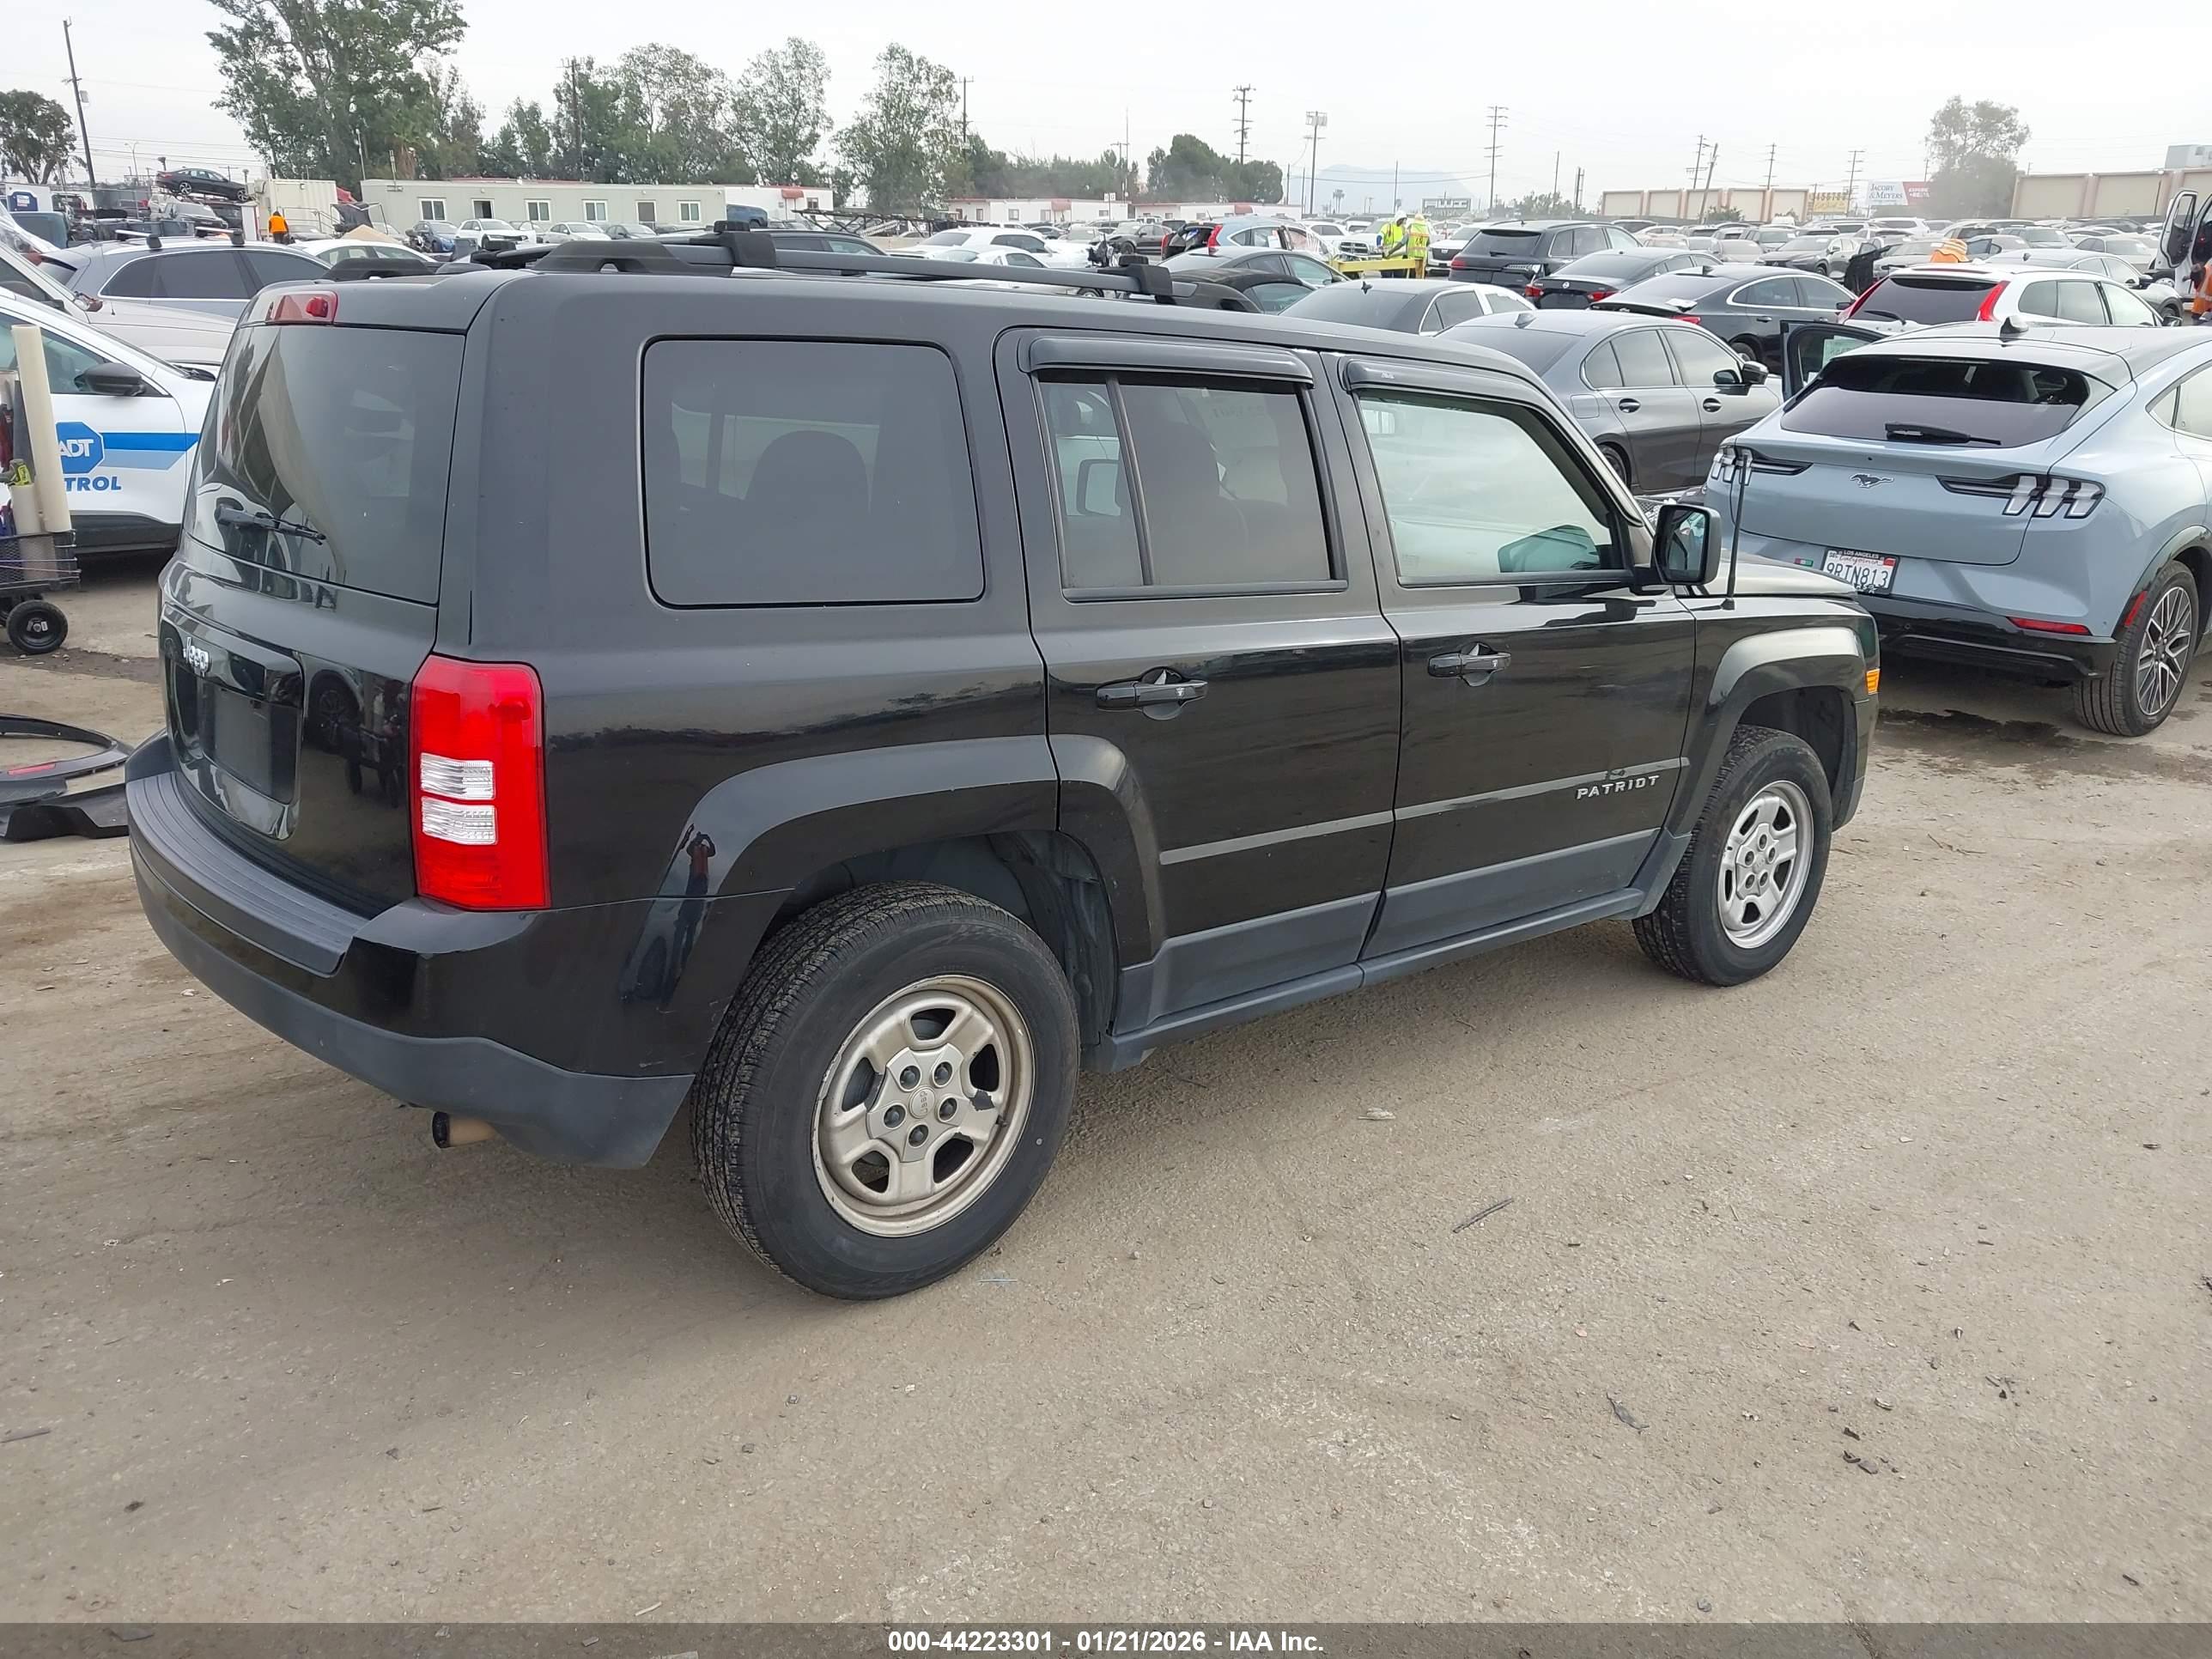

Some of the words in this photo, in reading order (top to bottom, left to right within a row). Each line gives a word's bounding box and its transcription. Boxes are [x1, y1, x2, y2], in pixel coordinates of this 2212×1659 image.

[58, 439, 94, 458] ADT
[64, 476, 122, 492] TROL
[1826, 562, 1889, 588] 9RTN813
[1576, 775, 1660, 799] PATRIOT
